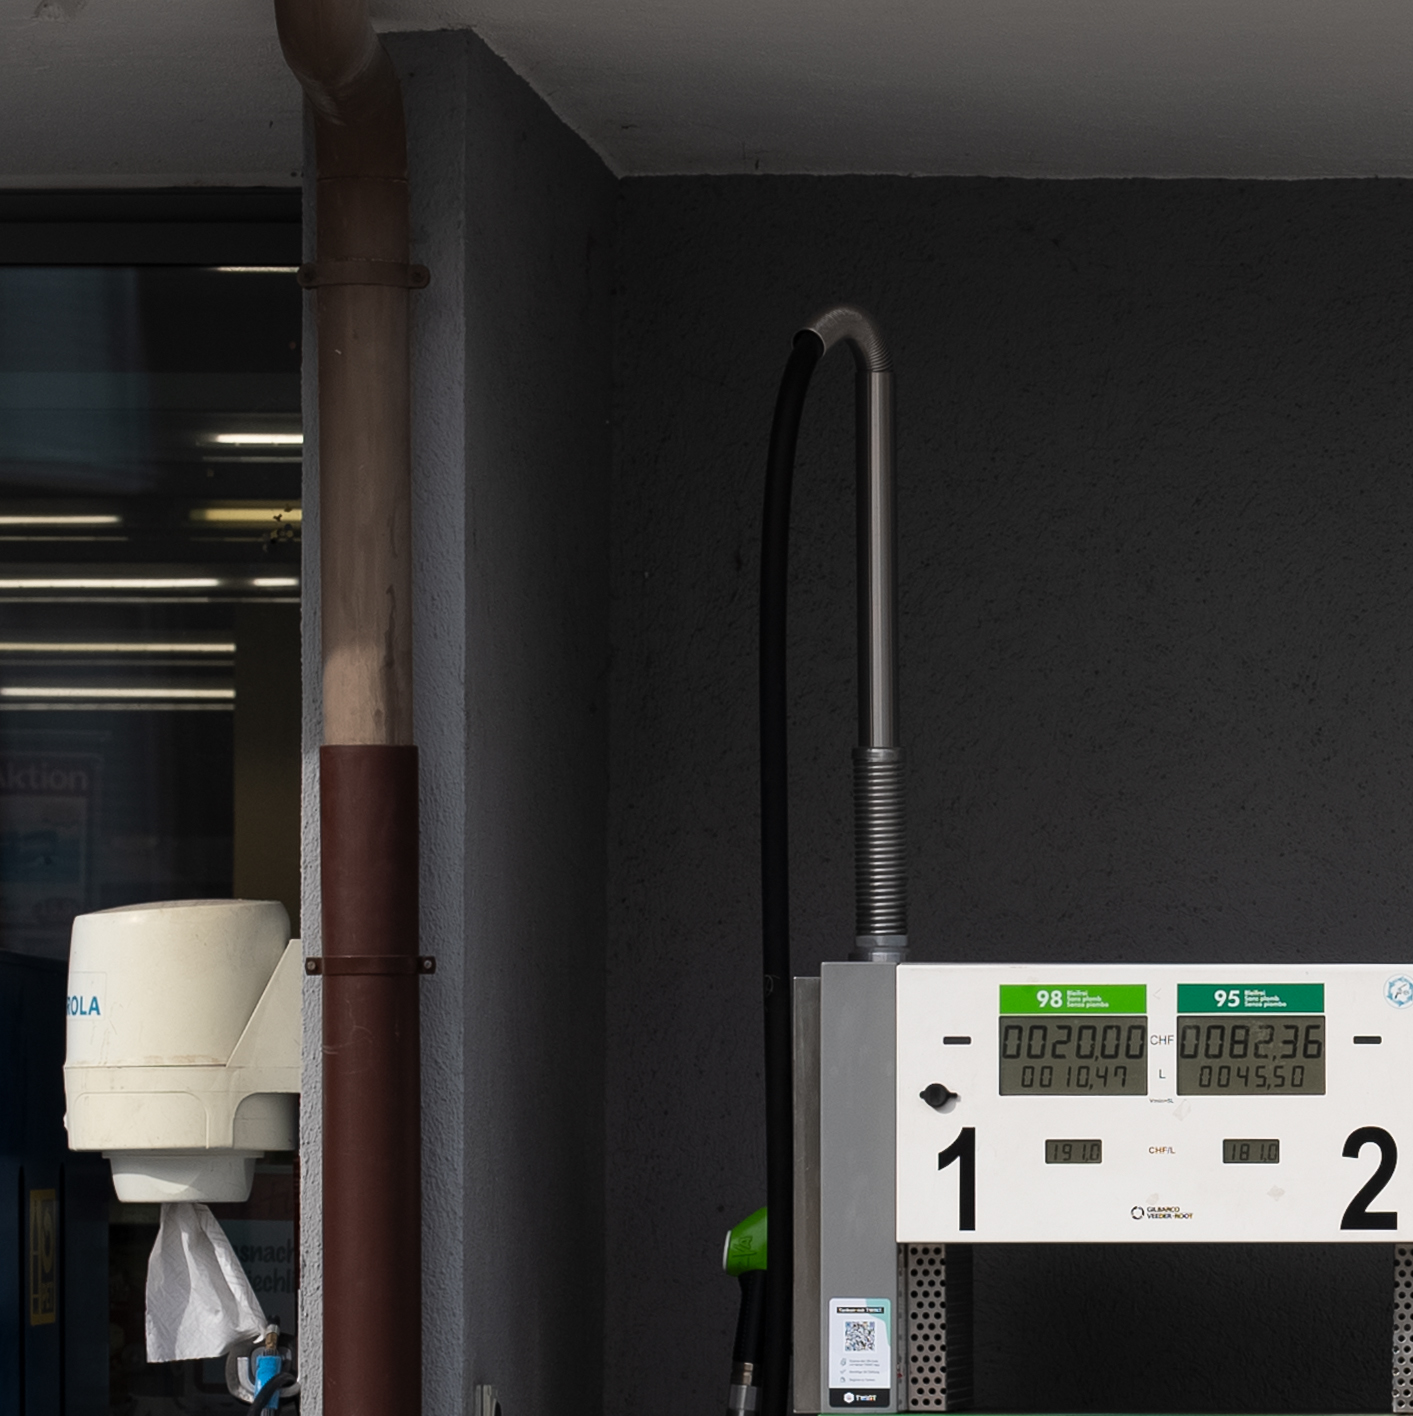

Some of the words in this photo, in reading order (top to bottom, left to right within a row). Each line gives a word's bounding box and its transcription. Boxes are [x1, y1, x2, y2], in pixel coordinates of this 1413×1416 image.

[1036, 989, 1063, 1008] 98
[1213, 989, 1240, 1007] 95
[1149, 1034, 1174, 1046] CHF
[1158, 1068, 1166, 1079] L
[1148, 1146, 1176, 1154] CHF/L
[938, 1126, 976, 1231] 1
[1340, 1126, 1398, 1231] 2
